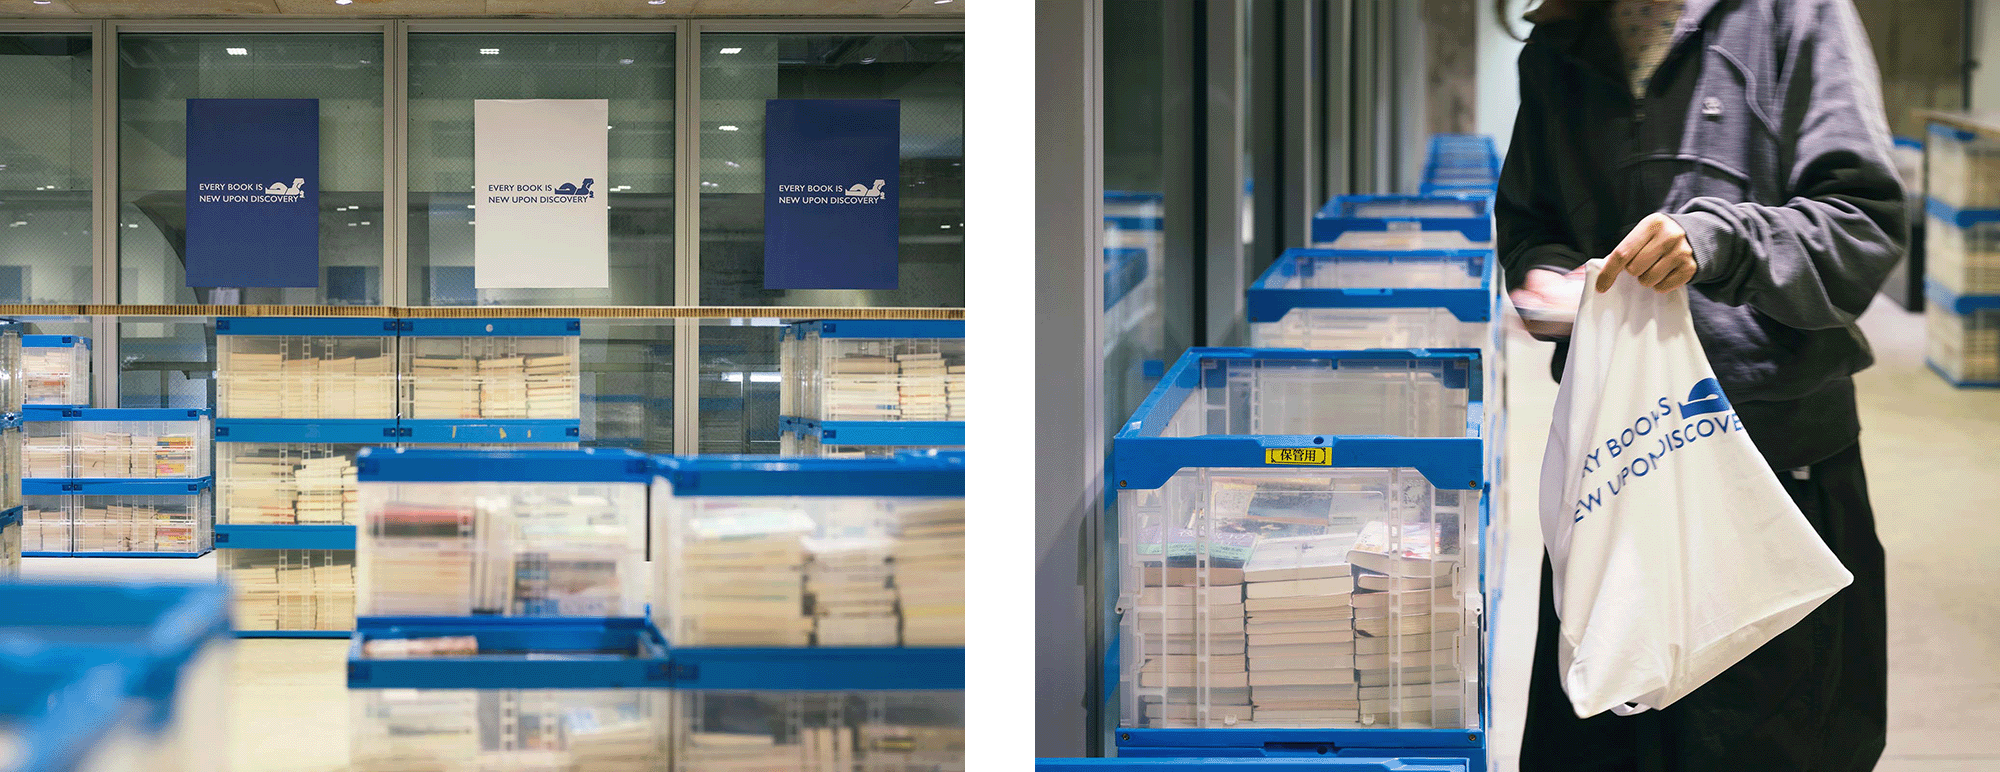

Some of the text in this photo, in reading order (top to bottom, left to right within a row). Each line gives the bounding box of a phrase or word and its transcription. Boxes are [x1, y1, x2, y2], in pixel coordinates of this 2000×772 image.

[199, 183, 263, 191] EVERY BOOK IS
[488, 184, 553, 192] EVERY BOOK IS
[779, 184, 843, 192] EVERY BOOK IS
[199, 195, 299, 203] NEW UPON DISCOVERY
[488, 196, 588, 204] NEW UPON DISCOVERY
[779, 196, 880, 204] NEW UPON DISCOVERY
[1280, 448, 1316, 462] 保管用
